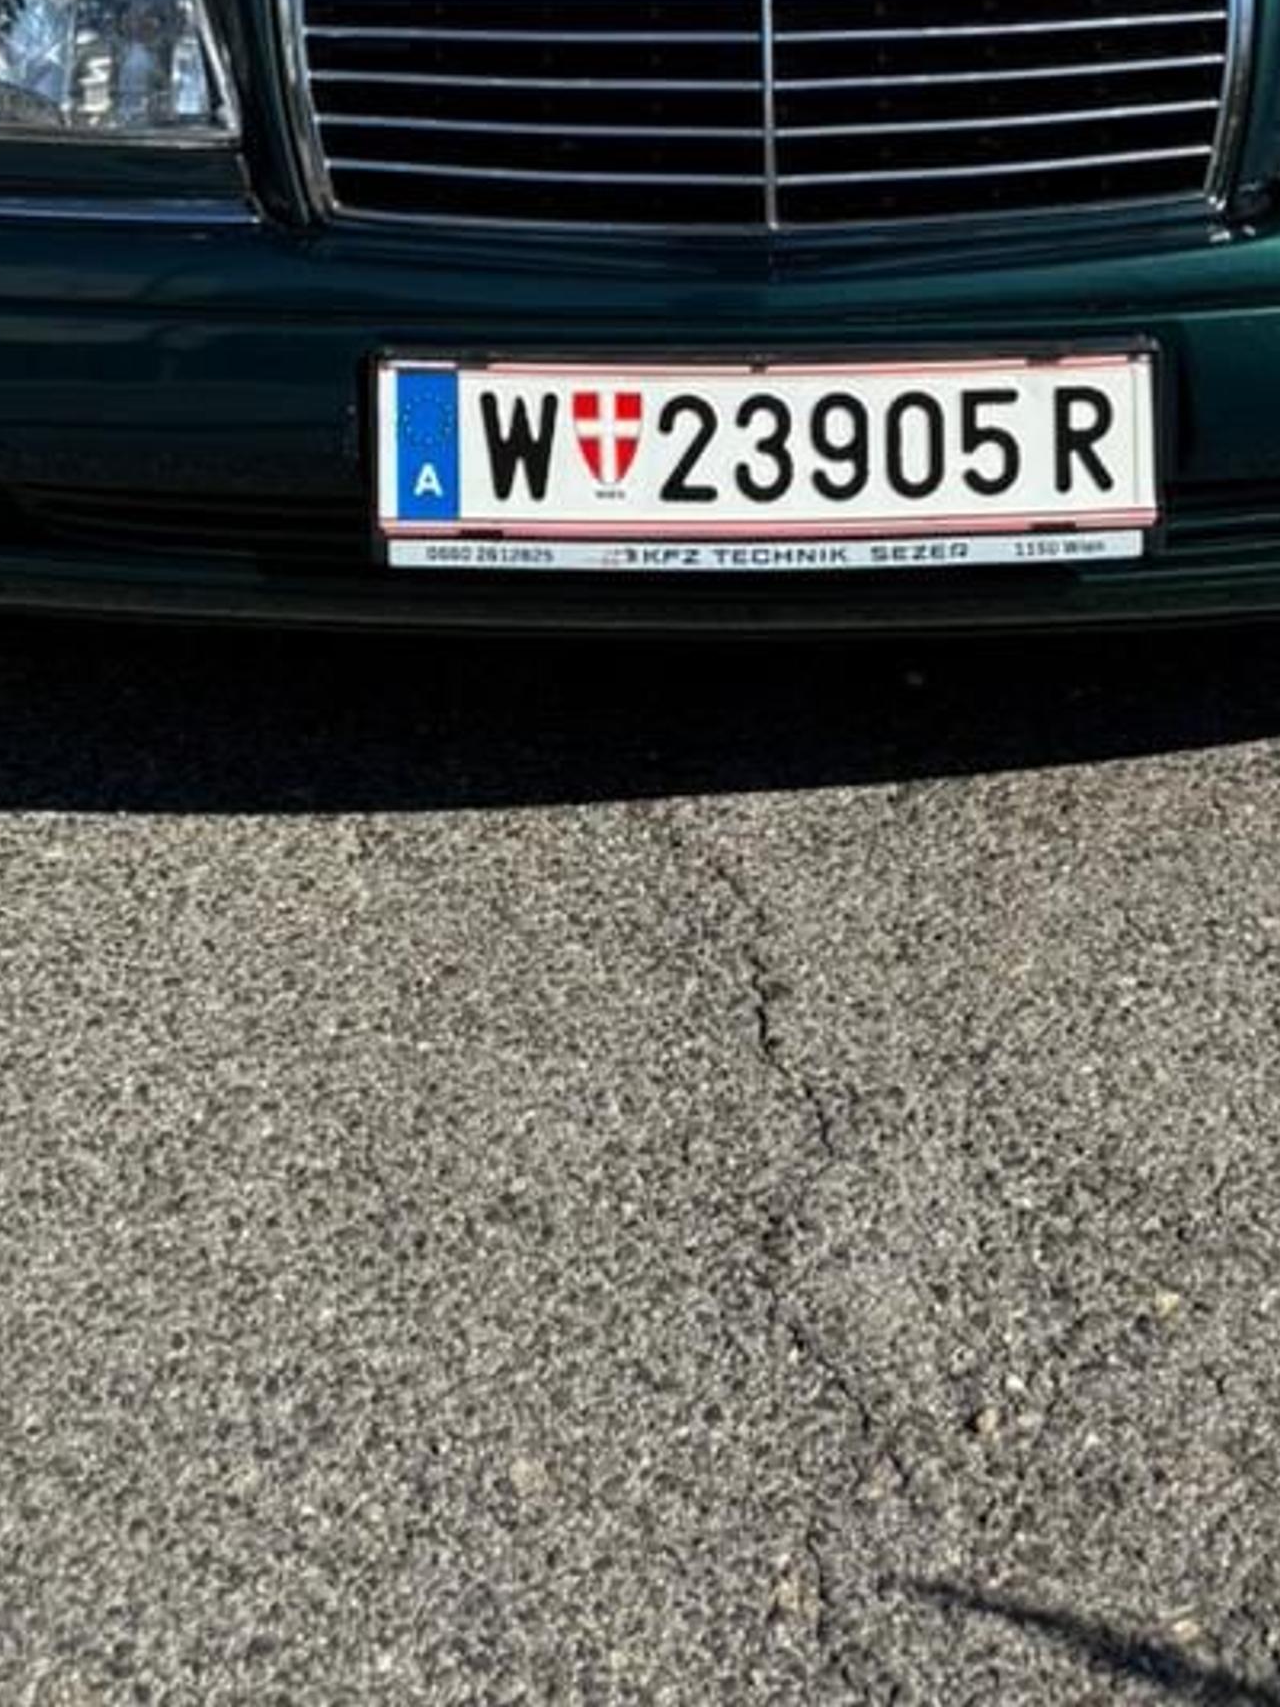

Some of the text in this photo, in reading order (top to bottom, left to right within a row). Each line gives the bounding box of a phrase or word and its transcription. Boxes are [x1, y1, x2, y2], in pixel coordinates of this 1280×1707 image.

[480, 386, 1115, 503] W 23905 R
[414, 462, 443, 497] A
[713, 547, 847, 565] TECHNIK
[870, 541, 970, 562] SEZER
